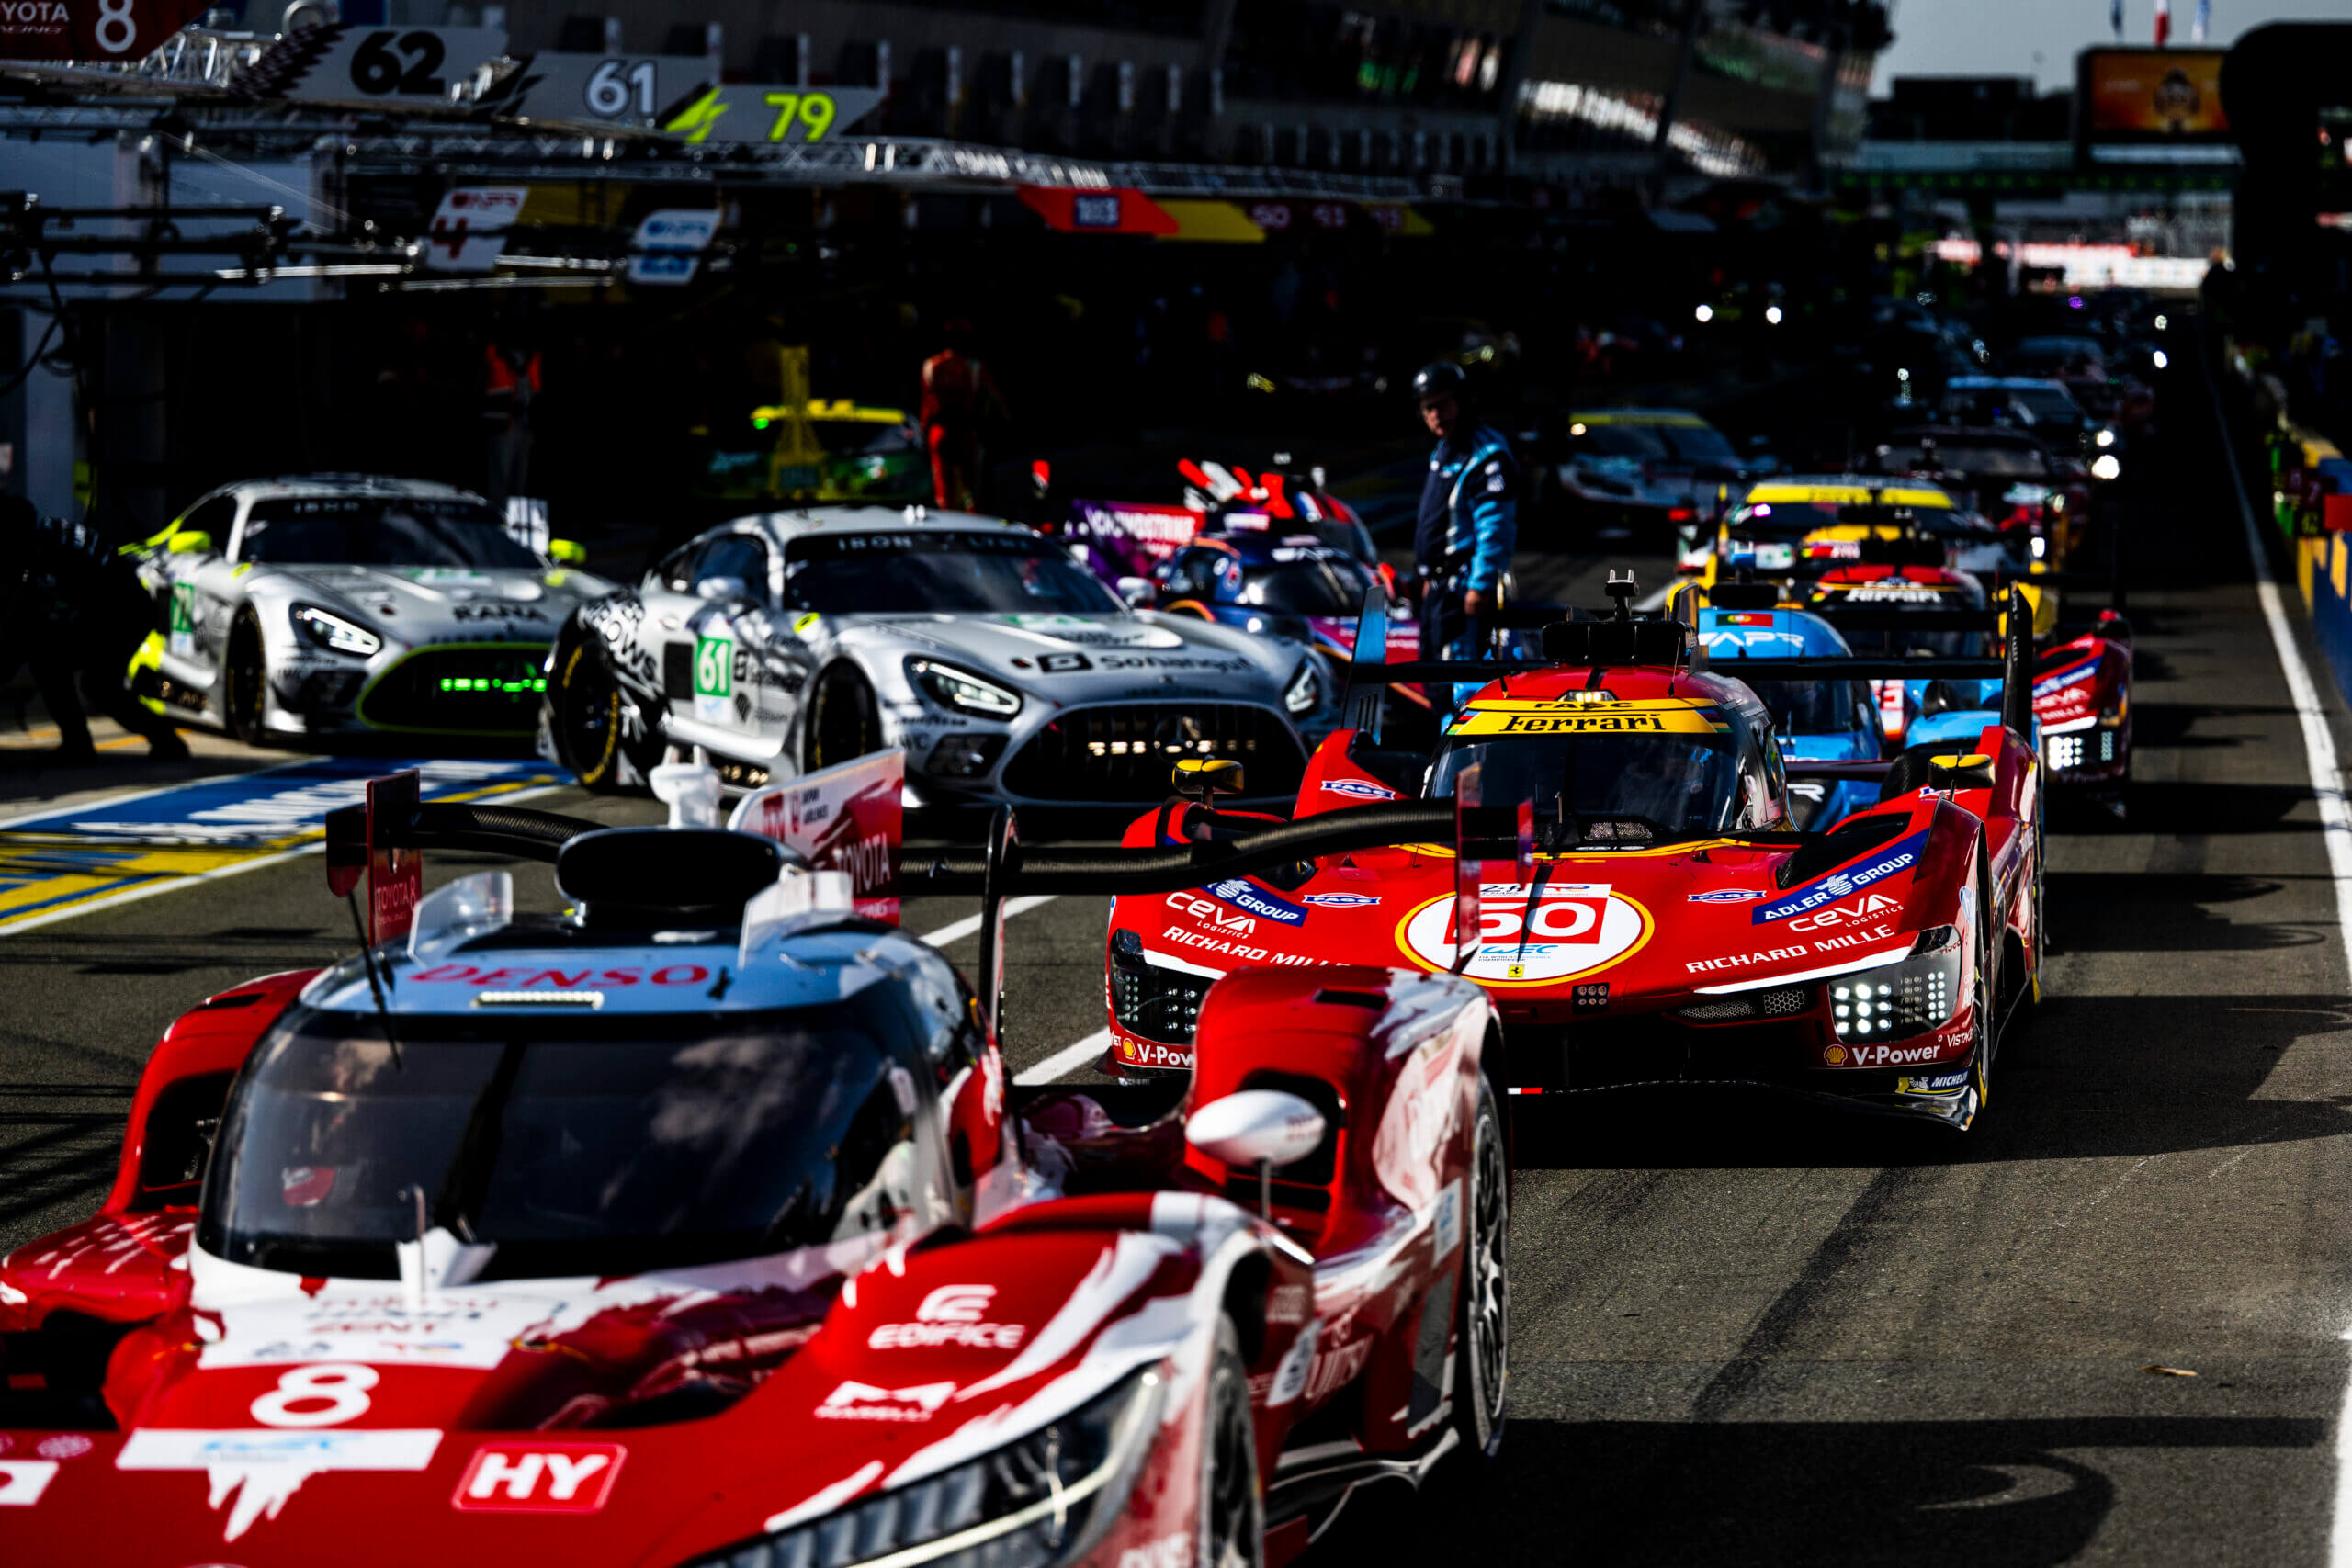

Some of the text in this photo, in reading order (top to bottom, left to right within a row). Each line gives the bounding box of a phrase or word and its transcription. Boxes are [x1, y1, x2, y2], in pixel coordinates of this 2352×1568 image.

[0, 0, 137, 53] YOTA 8
[350, 30, 446, 95] 62
[585, 60, 657, 118] 61
[763, 93, 836, 143] 79
[698, 639, 729, 694] 61
[1498, 713, 1667, 733] Ferrari
[835, 832, 892, 895] TOYOTA
[375, 874, 417, 912] TOYOTA 8
[1763, 852, 1915, 920] ADLER GROUP
[1165, 891, 1257, 935] CEVA
[1235, 893, 1299, 921] GROUP
[1453, 901, 1597, 938] 50
[1788, 893, 1900, 933] CEVA
[1845, 905, 1905, 929] LOGISTICS
[1162, 925, 1269, 961] RICHARD
[1196, 919, 1250, 940] LOGISTICS
[1685, 923, 1896, 974] RICHARD MILLE
[408, 964, 709, 989] DENSO
[1137, 1043, 1195, 1066] V-Pow
[1851, 1044, 1941, 1066] V-Power
[1931, 1070, 1970, 1088] MICHELIN
[867, 1322, 1027, 1350] EDIFICE
[249, 1360, 380, 1427] 8
[469, 1452, 610, 1500] HY
